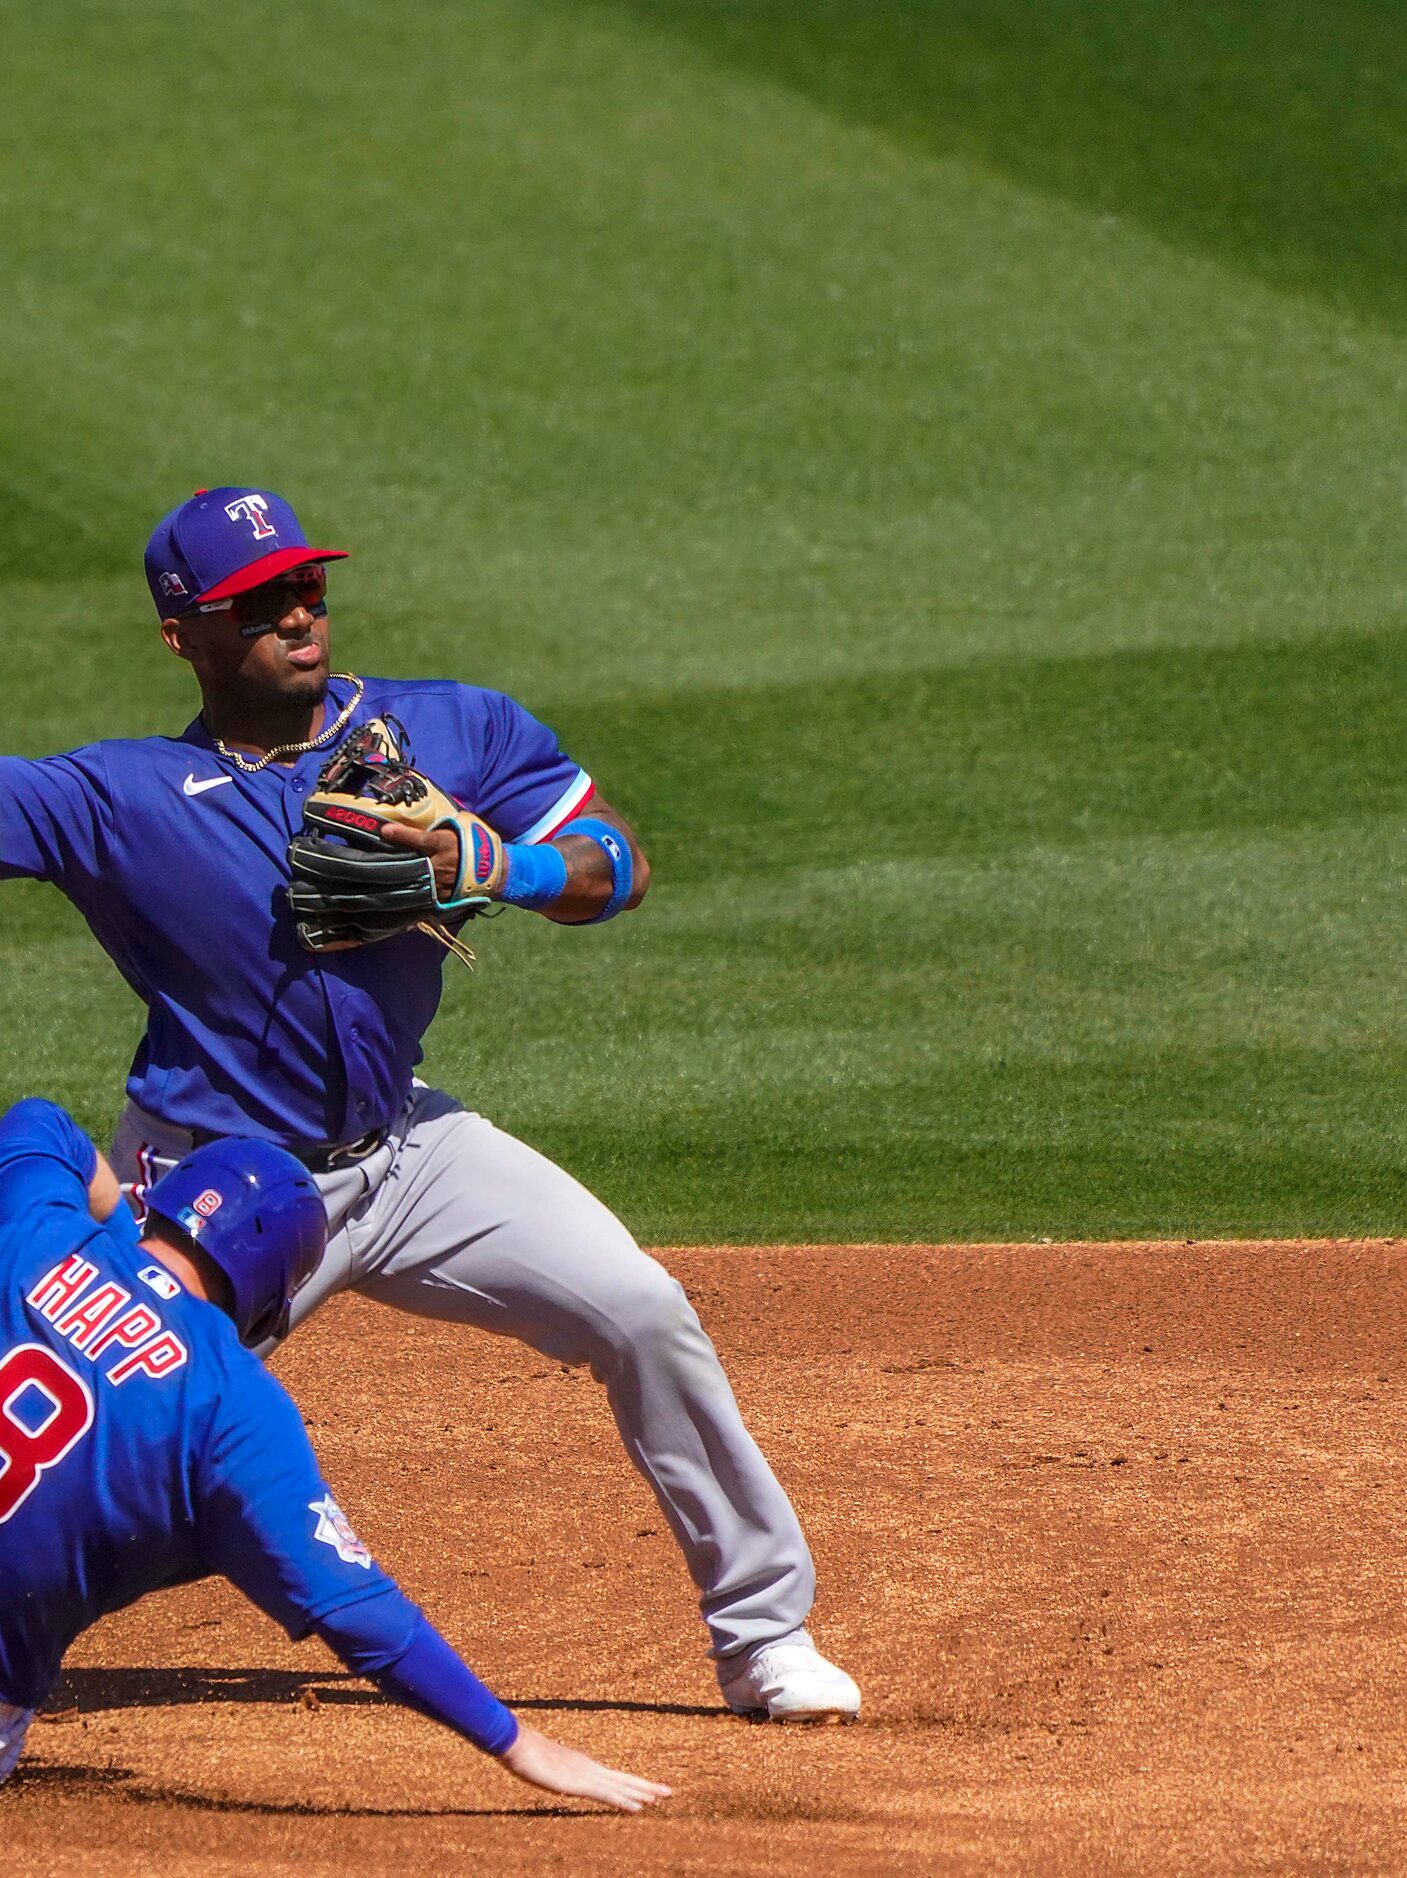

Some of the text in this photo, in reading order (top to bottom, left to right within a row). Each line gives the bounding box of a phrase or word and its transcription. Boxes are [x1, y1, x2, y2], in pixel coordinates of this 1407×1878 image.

[224, 494, 276, 540] T
[193, 1189, 222, 1217] 8
[25, 1253, 188, 1387] HAPP
